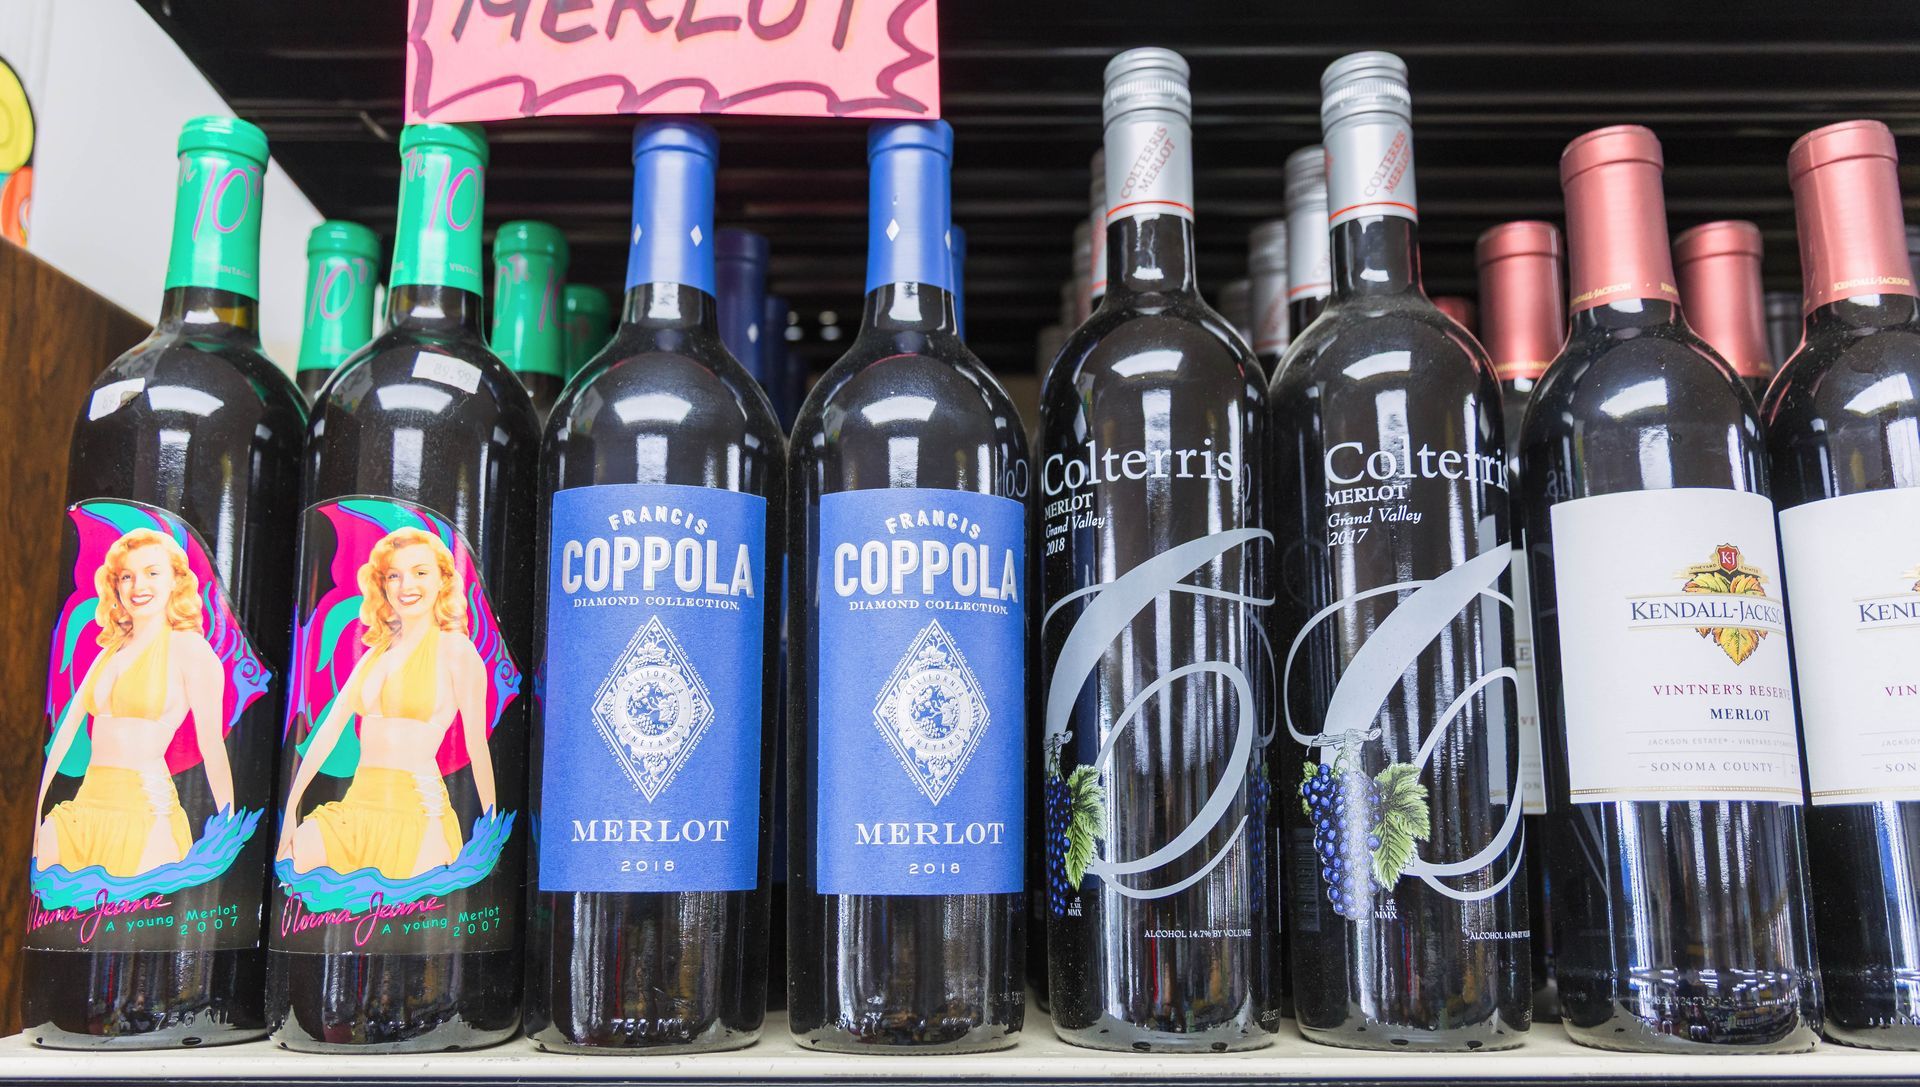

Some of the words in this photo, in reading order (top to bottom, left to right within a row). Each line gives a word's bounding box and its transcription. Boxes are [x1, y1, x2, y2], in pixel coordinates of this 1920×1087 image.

[1138, 138, 1176, 192] MERLOT
[1044, 439, 1235, 496] Colterris
[1044, 492, 1094, 521] MERLOT
[1325, 484, 1408, 507] MERLOT
[608, 505, 708, 536] FRANCIS
[885, 509, 981, 540] FRANCIS
[1045, 518, 1068, 539] Grand
[1071, 511, 1106, 530] Valley
[1328, 507, 1373, 528] Grand
[1378, 505, 1422, 525] Valley
[1045, 537, 1066, 557] 2018
[1328, 528, 1368, 547] 2017
[561, 536, 755, 599] COPPOLA
[834, 539, 1018, 603] COPPOLA
[574, 596, 640, 608] DIAMOND
[849, 600, 920, 611] DIAMOND
[1631, 600, 1783, 625] KENDALL-JACKSO
[623, 670, 685, 693] CALIFORNIA
[905, 673, 964, 698] CALIFORNIA
[1653, 684, 1744, 696] VINTNER'S
[1710, 708, 1770, 722] MERLOT
[621, 723, 684, 747] VINEYARDS
[905, 727, 965, 750] VINEYARDS
[1650, 761, 1717, 773] SONOMA
[1723, 761, 1774, 773] COUNTY
[571, 820, 729, 842] MERLOT
[855, 822, 1005, 845] MERLOT
[621, 861, 675, 872] 2018
[909, 863, 961, 875] 2018
[26, 889, 86, 935] Norma
[80, 888, 172, 944] Jeane
[105, 921, 115, 932] A
[127, 915, 174, 932] young
[186, 904, 238, 921] Merlot
[180, 915, 239, 935] 2007
[281, 885, 361, 940] Norma
[354, 891, 446, 947] Jeane
[382, 924, 391, 935] A
[403, 917, 448, 934] young
[458, 905, 500, 923] Merlot
[452, 918, 500, 938] 2007
[1144, 929, 1187, 938] ALCOHOL
[1223, 928, 1252, 937] VOLUME
[1470, 931, 1504, 940] ALCOHOL
